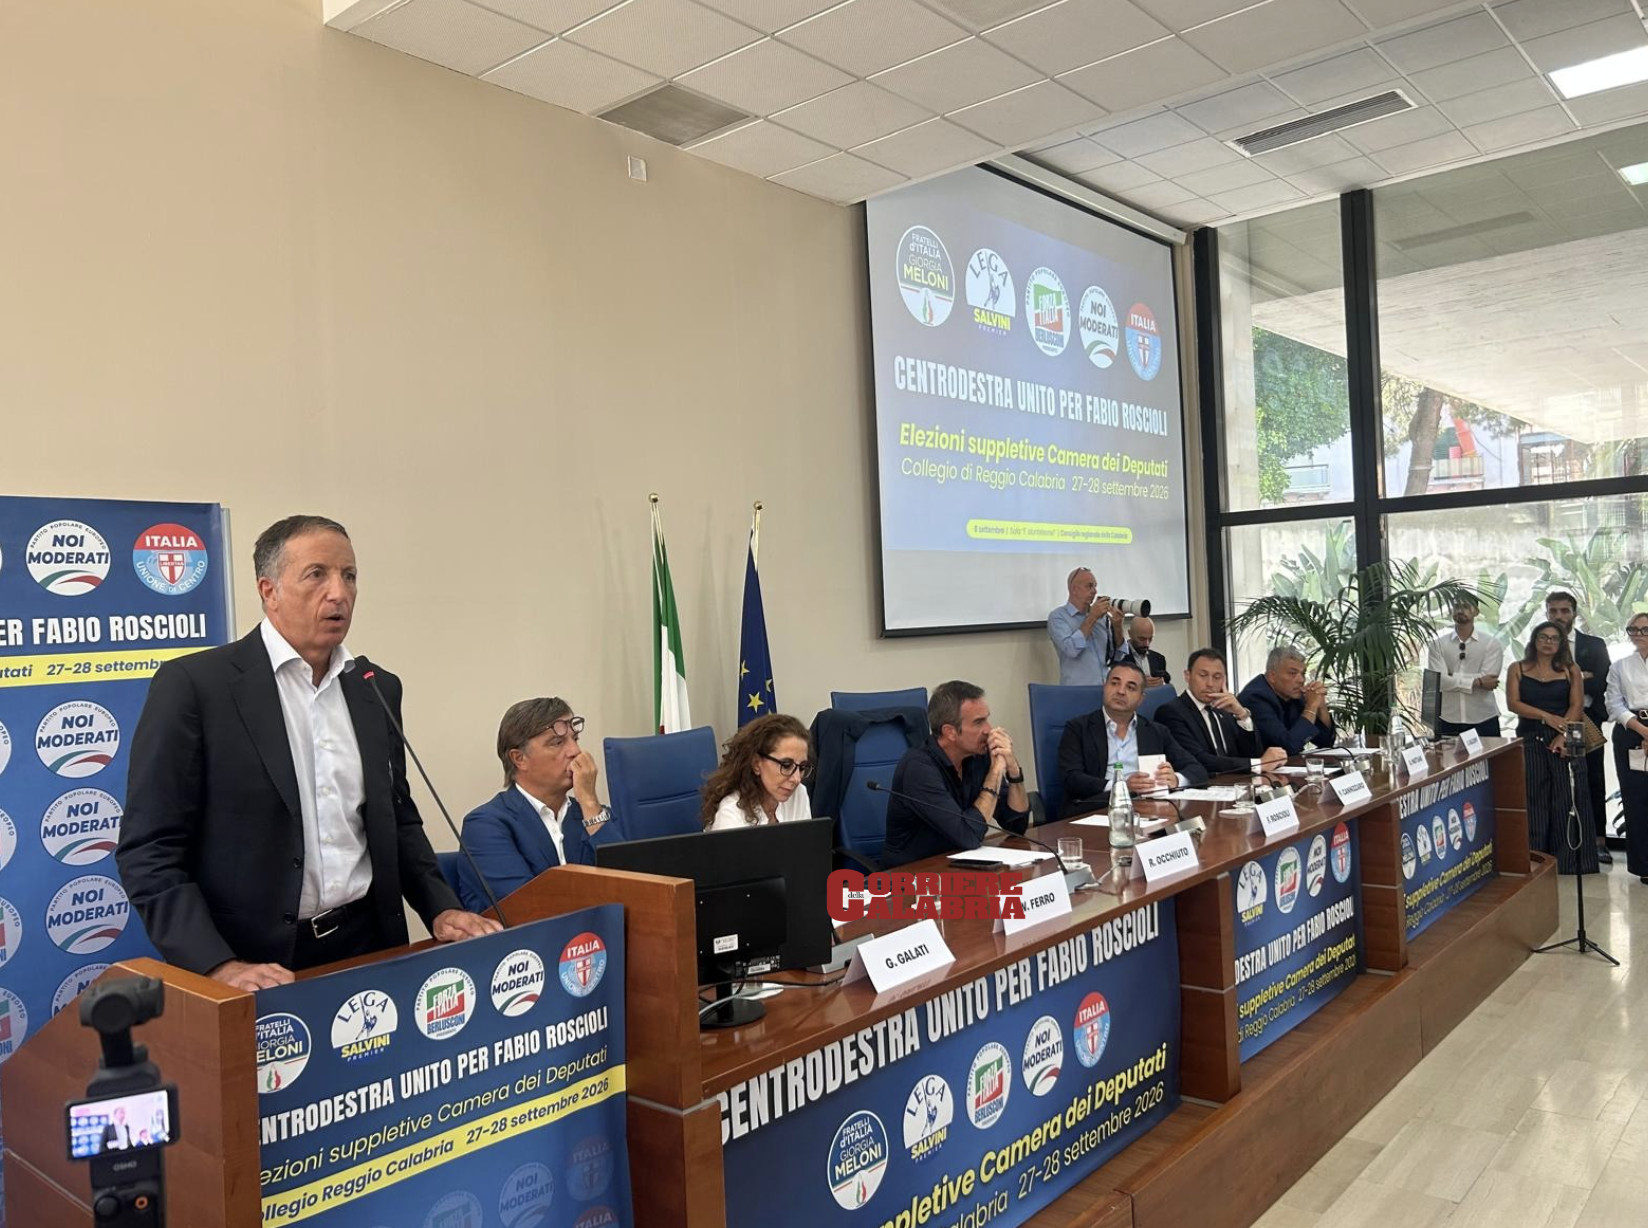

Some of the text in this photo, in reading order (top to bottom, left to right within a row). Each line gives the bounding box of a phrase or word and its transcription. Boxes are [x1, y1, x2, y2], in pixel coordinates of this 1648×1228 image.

[909, 243, 941, 260] d'ITALIA
[912, 233, 939, 248] FRATELLI
[909, 254, 943, 272] GIORGIA
[970, 251, 1009, 287] LEGA
[904, 263, 948, 291] MELONI
[974, 309, 1011, 331] SALVINI
[1090, 300, 1106, 318] NOI
[1080, 317, 1119, 339] MODERATI
[1130, 313, 1157, 332] ITALIA
[894, 355, 1168, 437] CENTRODESTRA UNITO PER FABIO ROSCIOLI
[900, 422, 1168, 480] Elezioni suppletive Camera dei Deputati
[901, 457, 1169, 500] Collegio di Reggio Calabria 27-28 settembre 2026
[30, 522, 107, 550] PARTITO POPOLARE EUROPEO
[52, 535, 85, 548] NOI
[145, 535, 198, 548] ITALIA
[28, 551, 109, 565] MODERATI
[136, 561, 166, 590] UNIONE
[179, 560, 205, 591] CENTRO
[0, 613, 207, 647] ER FABIO ROSCIOLI
[46, 658, 165, 676] 27-28 settemb
[40, 703, 116, 733] PARTITO POPOLARE EUROPEO
[61, 714, 94, 730] NOI
[37, 729, 118, 749] MODERATI
[45, 790, 120, 822] PARTITO POPOLARE EUROPEO
[66, 801, 99, 818] NOI
[1271, 810, 1291, 822] ROSCIOLI
[1334, 830, 1349, 845] ITALIA
[1148, 847, 1189, 869] R. OCCHIUTO
[1238, 862, 1262, 889] LEGA
[51, 878, 125, 912] PARTITO POPOLARE EUROPEO
[71, 888, 104, 906] NOI
[1030, 892, 1055, 909] FERRO
[1, 900, 20, 927] UROPEO
[48, 901, 128, 928] MODERATI
[1241, 904, 1263, 923] SALVINI
[567, 940, 600, 958] ITALIA
[885, 944, 930, 969] G. GALATI
[1235, 946, 1267, 985] DESTRA
[1268, 933, 1291, 966] UNITO
[1292, 923, 1306, 953] PER
[1307, 911, 1325, 944] FABIO
[508, 960, 529, 976] NOI
[925, 976, 988, 1043] UNITO
[995, 957, 1032, 1012] PER
[1036, 933, 1088, 992] FABIO
[1092, 901, 1159, 965] ROSCIOLI
[56, 979, 73, 1002] PARTITO
[75, 965, 107, 978] POPOLARE
[416, 983, 428, 1011] PARTITO
[429, 969, 458, 982] POPOLARE
[492, 970, 543, 995] MODERATI
[1239, 981, 1284, 1019] suppletive
[1285, 961, 1314, 990] Camera
[1315, 948, 1326, 969] dei
[3, 990, 25, 1019] EUROPEO
[337, 991, 389, 1023] LEGA
[433, 984, 457, 1007] FORZA
[1245, 1013, 1268, 1038] Reggio
[1268, 995, 1295, 1021] Calabria
[1316, 962, 1344, 990] settembre
[433, 999, 459, 1020] ITALIA
[1079, 1000, 1105, 1023] ITALIA
[256, 1019, 290, 1031] FRATELLI
[257, 1025, 294, 1040] 'ITALIA
[427, 1013, 465, 1034] BERLUSCONI
[257, 1035, 295, 1050] IORGIA
[341, 1034, 390, 1058] SALVINI
[1035, 1028, 1051, 1048] NOI
[257, 1041, 303, 1063] ELONI
[1023, 1040, 1062, 1071] MODERATI
[258, 1006, 608, 1146] NTRODESTRA UNITO PER FABIO ROSCIOLI
[906, 1077, 946, 1117] LEGA
[260, 1044, 608, 1185] ezioni suppletive Camera dei Deputati
[843, 1117, 870, 1136] FRATELLI
[840, 1125, 873, 1148] d'ITALIA
[879, 1169, 976, 1228] pletive
[980, 1112, 1062, 1184] Camera
[1065, 1086, 1092, 1128] dei
[1095, 1042, 1167, 1109] Deputati
[911, 1126, 947, 1160] SALVINI
[261, 1077, 609, 1221] llegio Reggio Calabria 27-28 settembre 2026
[573, 1143, 609, 1163] ITALIA
[840, 1136, 875, 1161] GIORGIA
[950, 1081, 1164, 1228] labria 27-28 settembre 2026
[835, 1142, 882, 1180] MELONI
[516, 1173, 538, 1191] NOI
[500, 1182, 556, 1212] MODERATI
